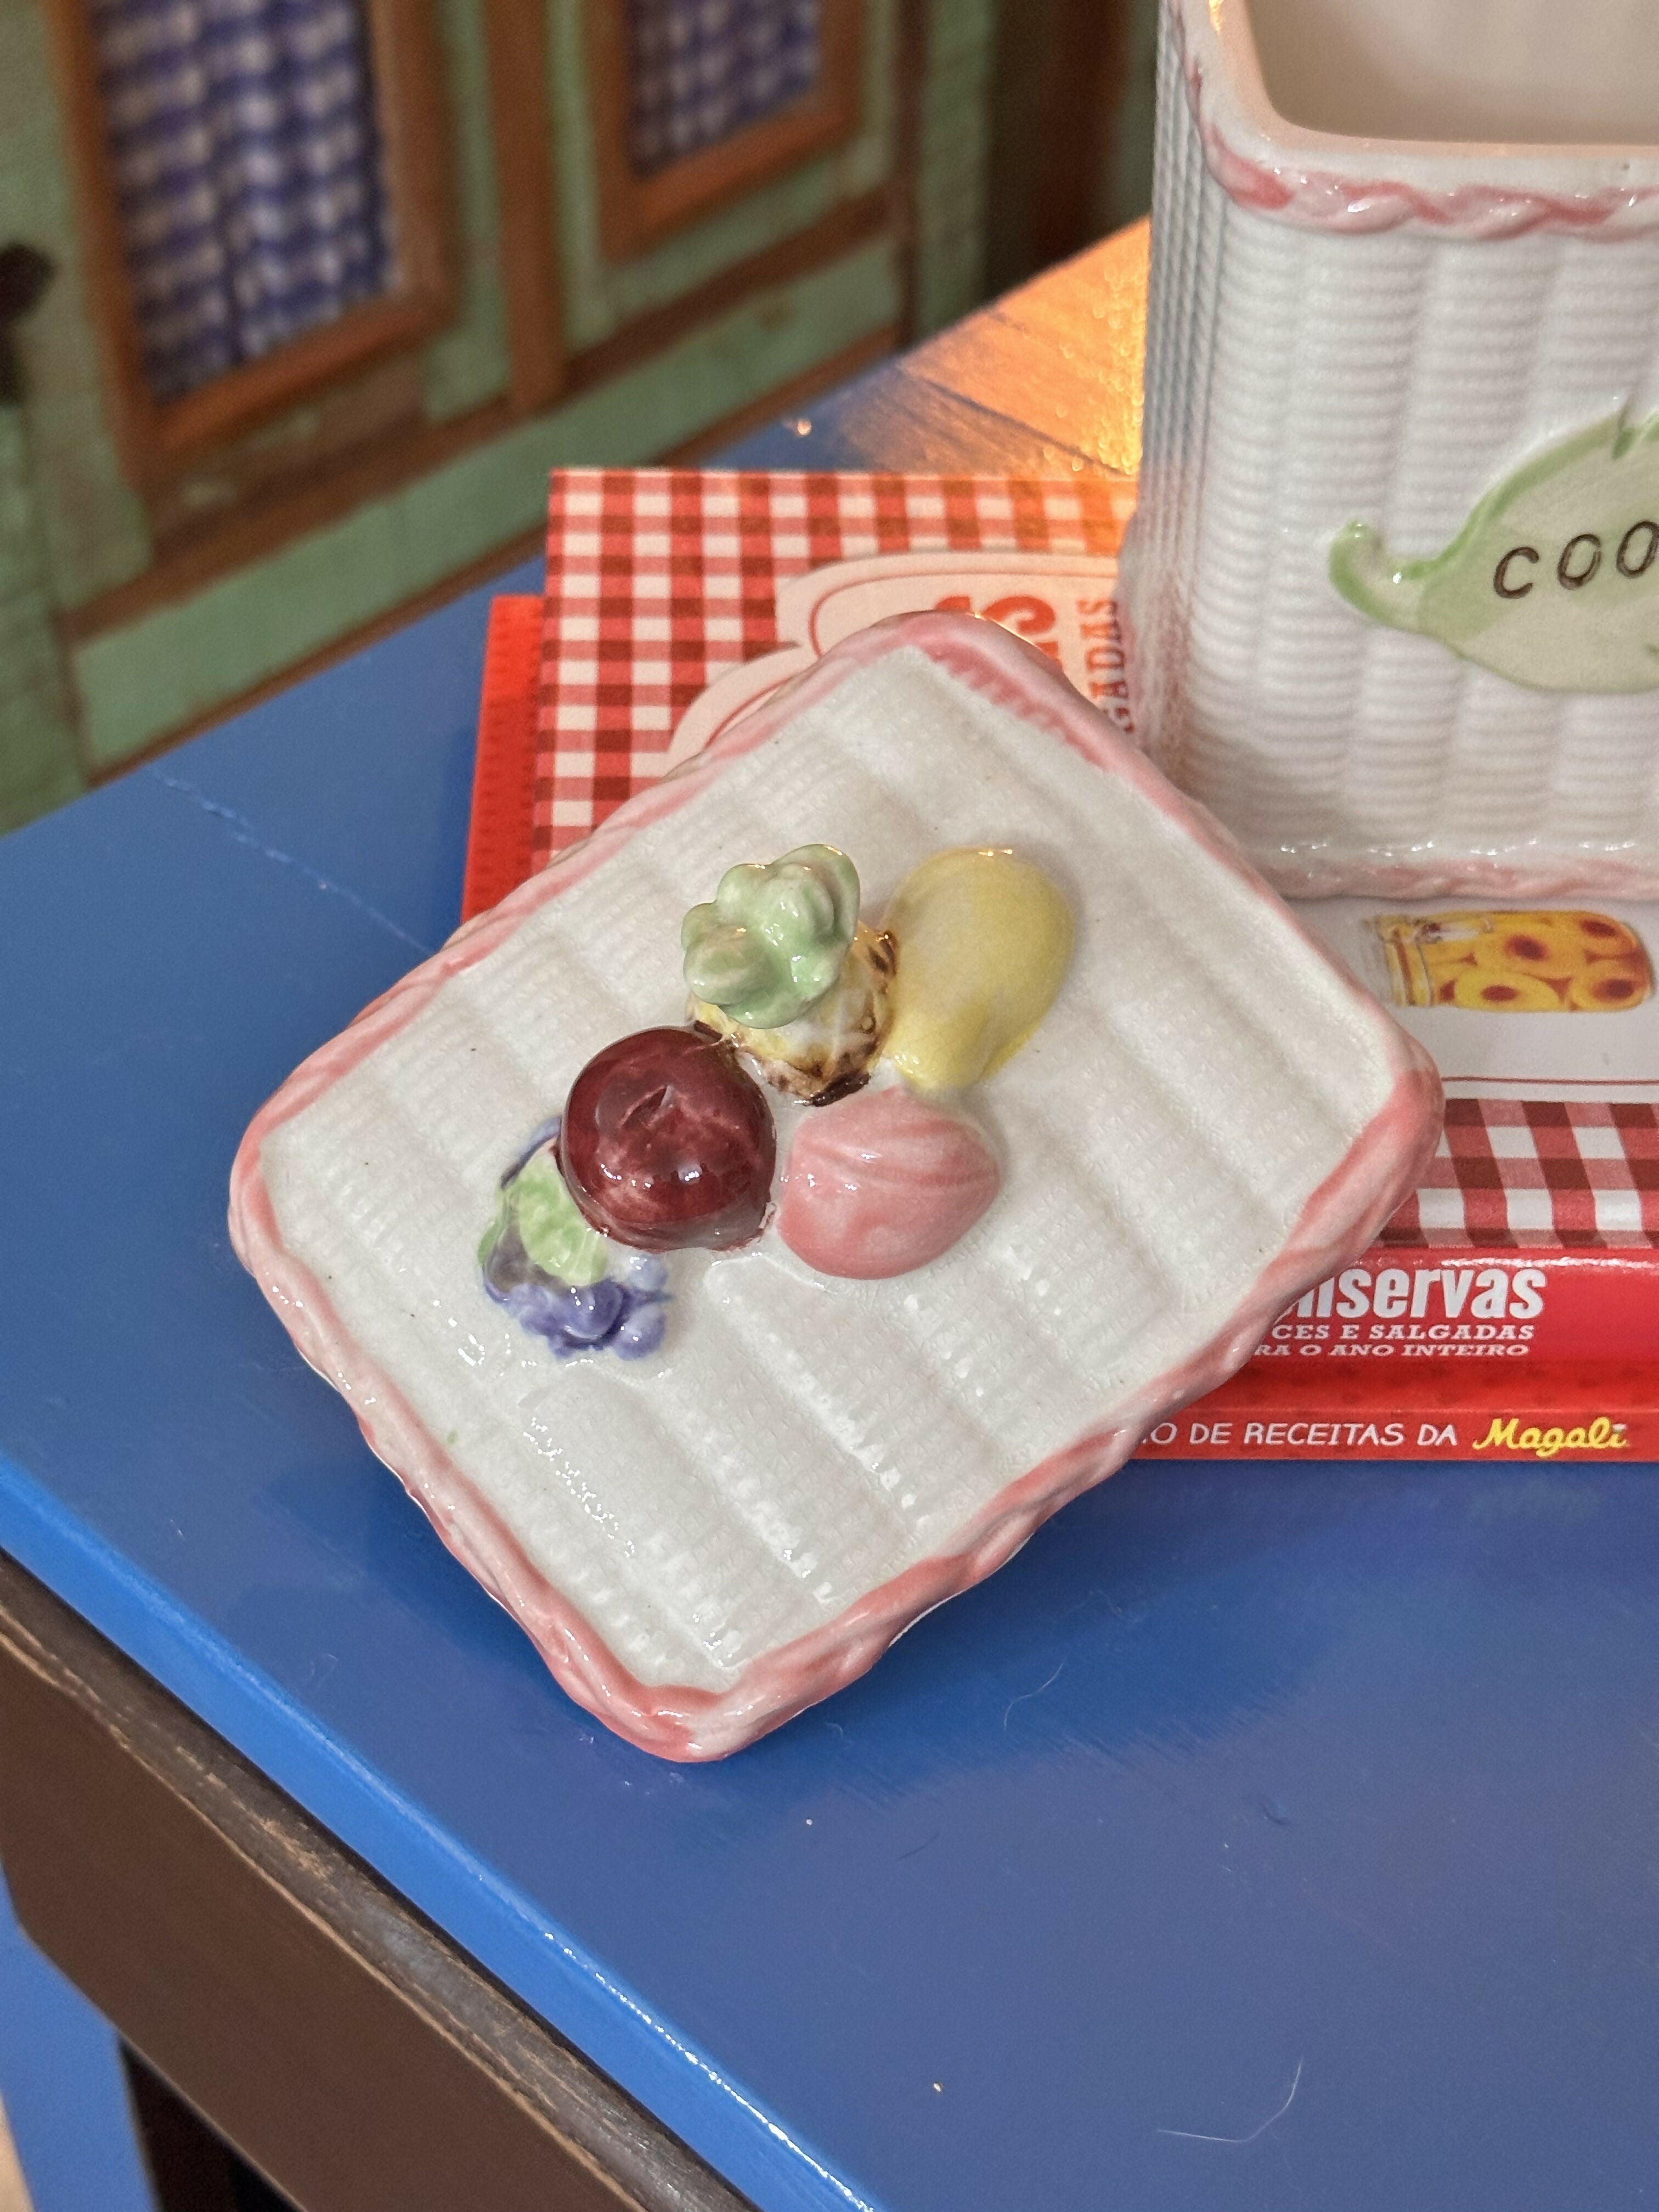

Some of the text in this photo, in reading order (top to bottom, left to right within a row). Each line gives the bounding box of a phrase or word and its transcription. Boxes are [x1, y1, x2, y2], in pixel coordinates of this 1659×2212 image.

[1272, 1324, 1534, 1340] CES E SALGADAS
[1299, 1344, 1321, 1356] O
[1329, 1344, 1395, 1356] ANO
[1402, 1344, 1529, 1357] INTEIRO
[1189, 1423, 1232, 1444] DE
[1244, 1423, 1404, 1446] RECEITAS
[1417, 1424, 1458, 1446] DA
[1472, 1416, 1628, 1457] Magali
